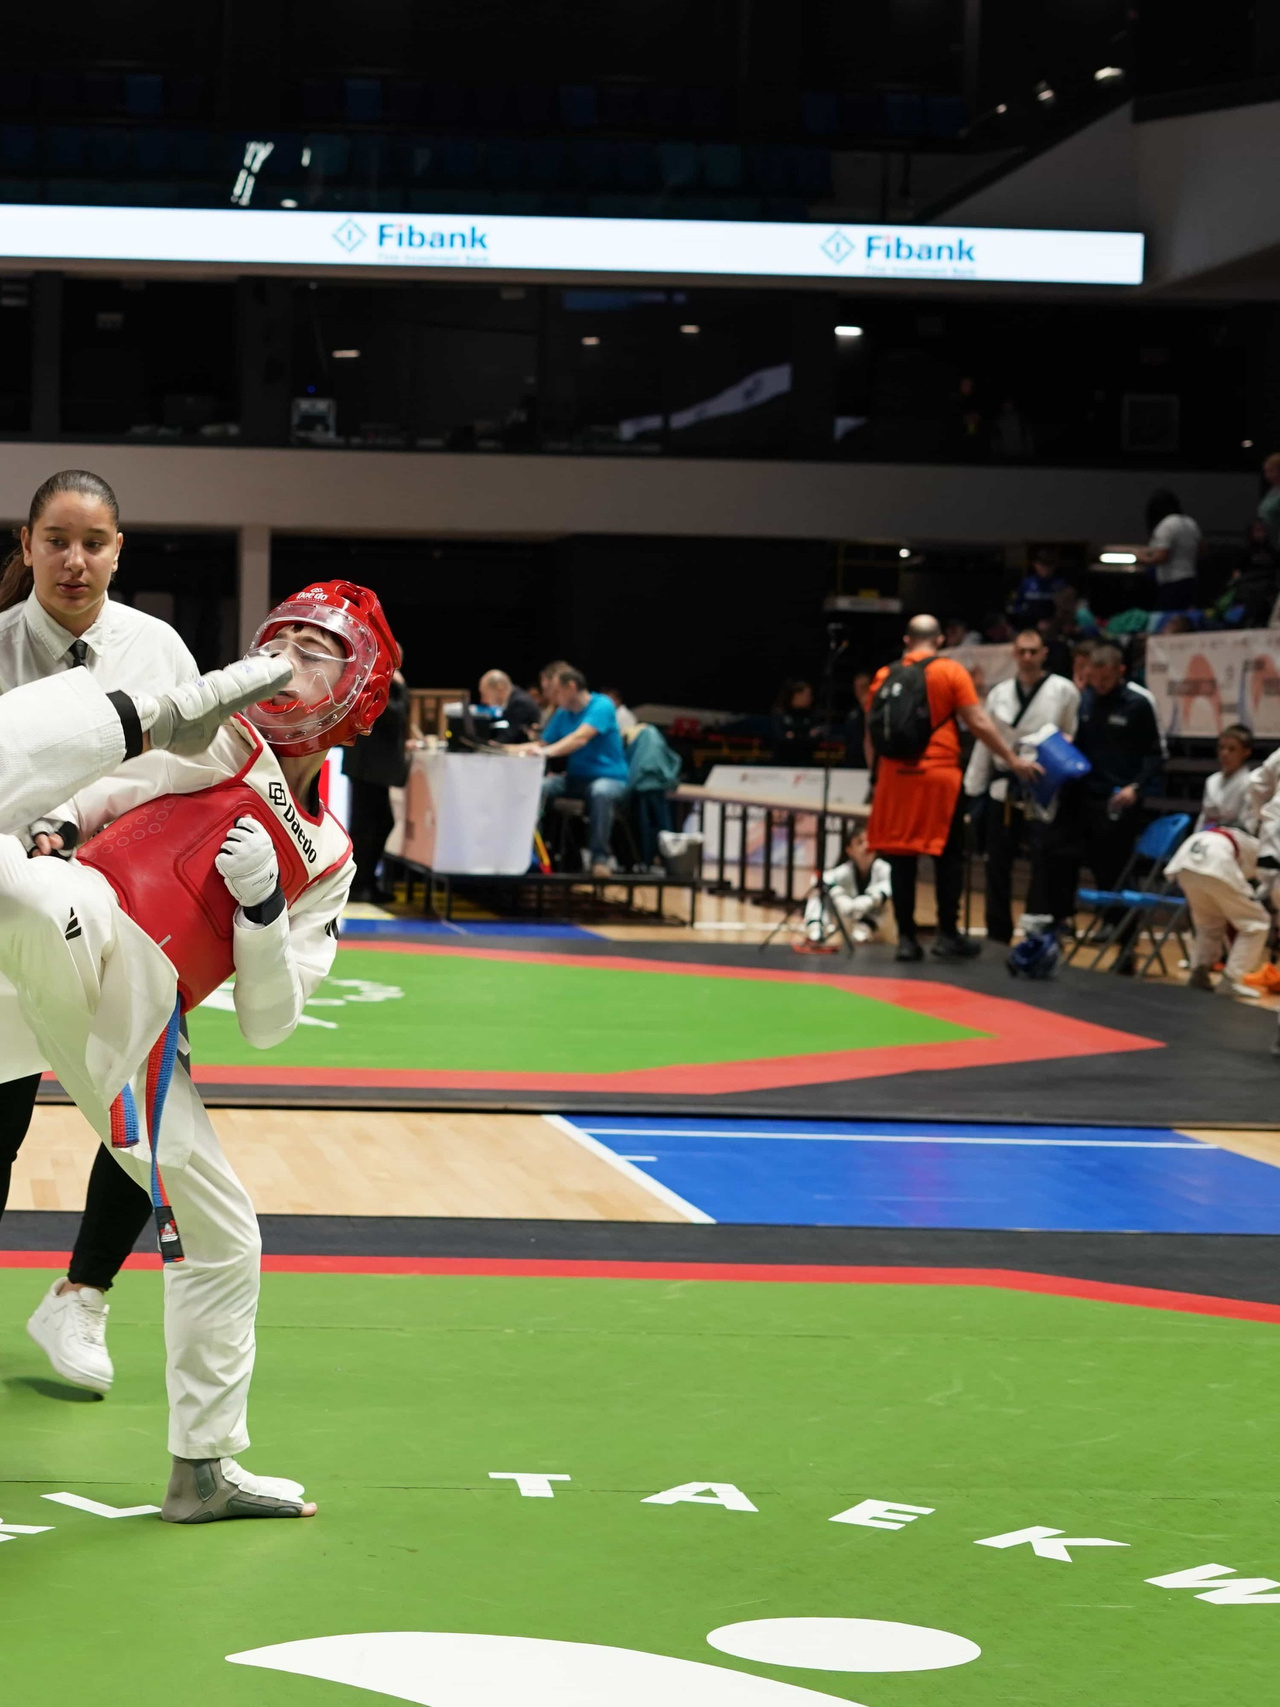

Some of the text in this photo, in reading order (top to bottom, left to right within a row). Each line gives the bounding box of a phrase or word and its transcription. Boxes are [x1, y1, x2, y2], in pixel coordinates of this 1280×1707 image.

[378, 223, 488, 249] Fibank
[866, 235, 975, 261] Fibank
[283, 803, 317, 864] Daedo
